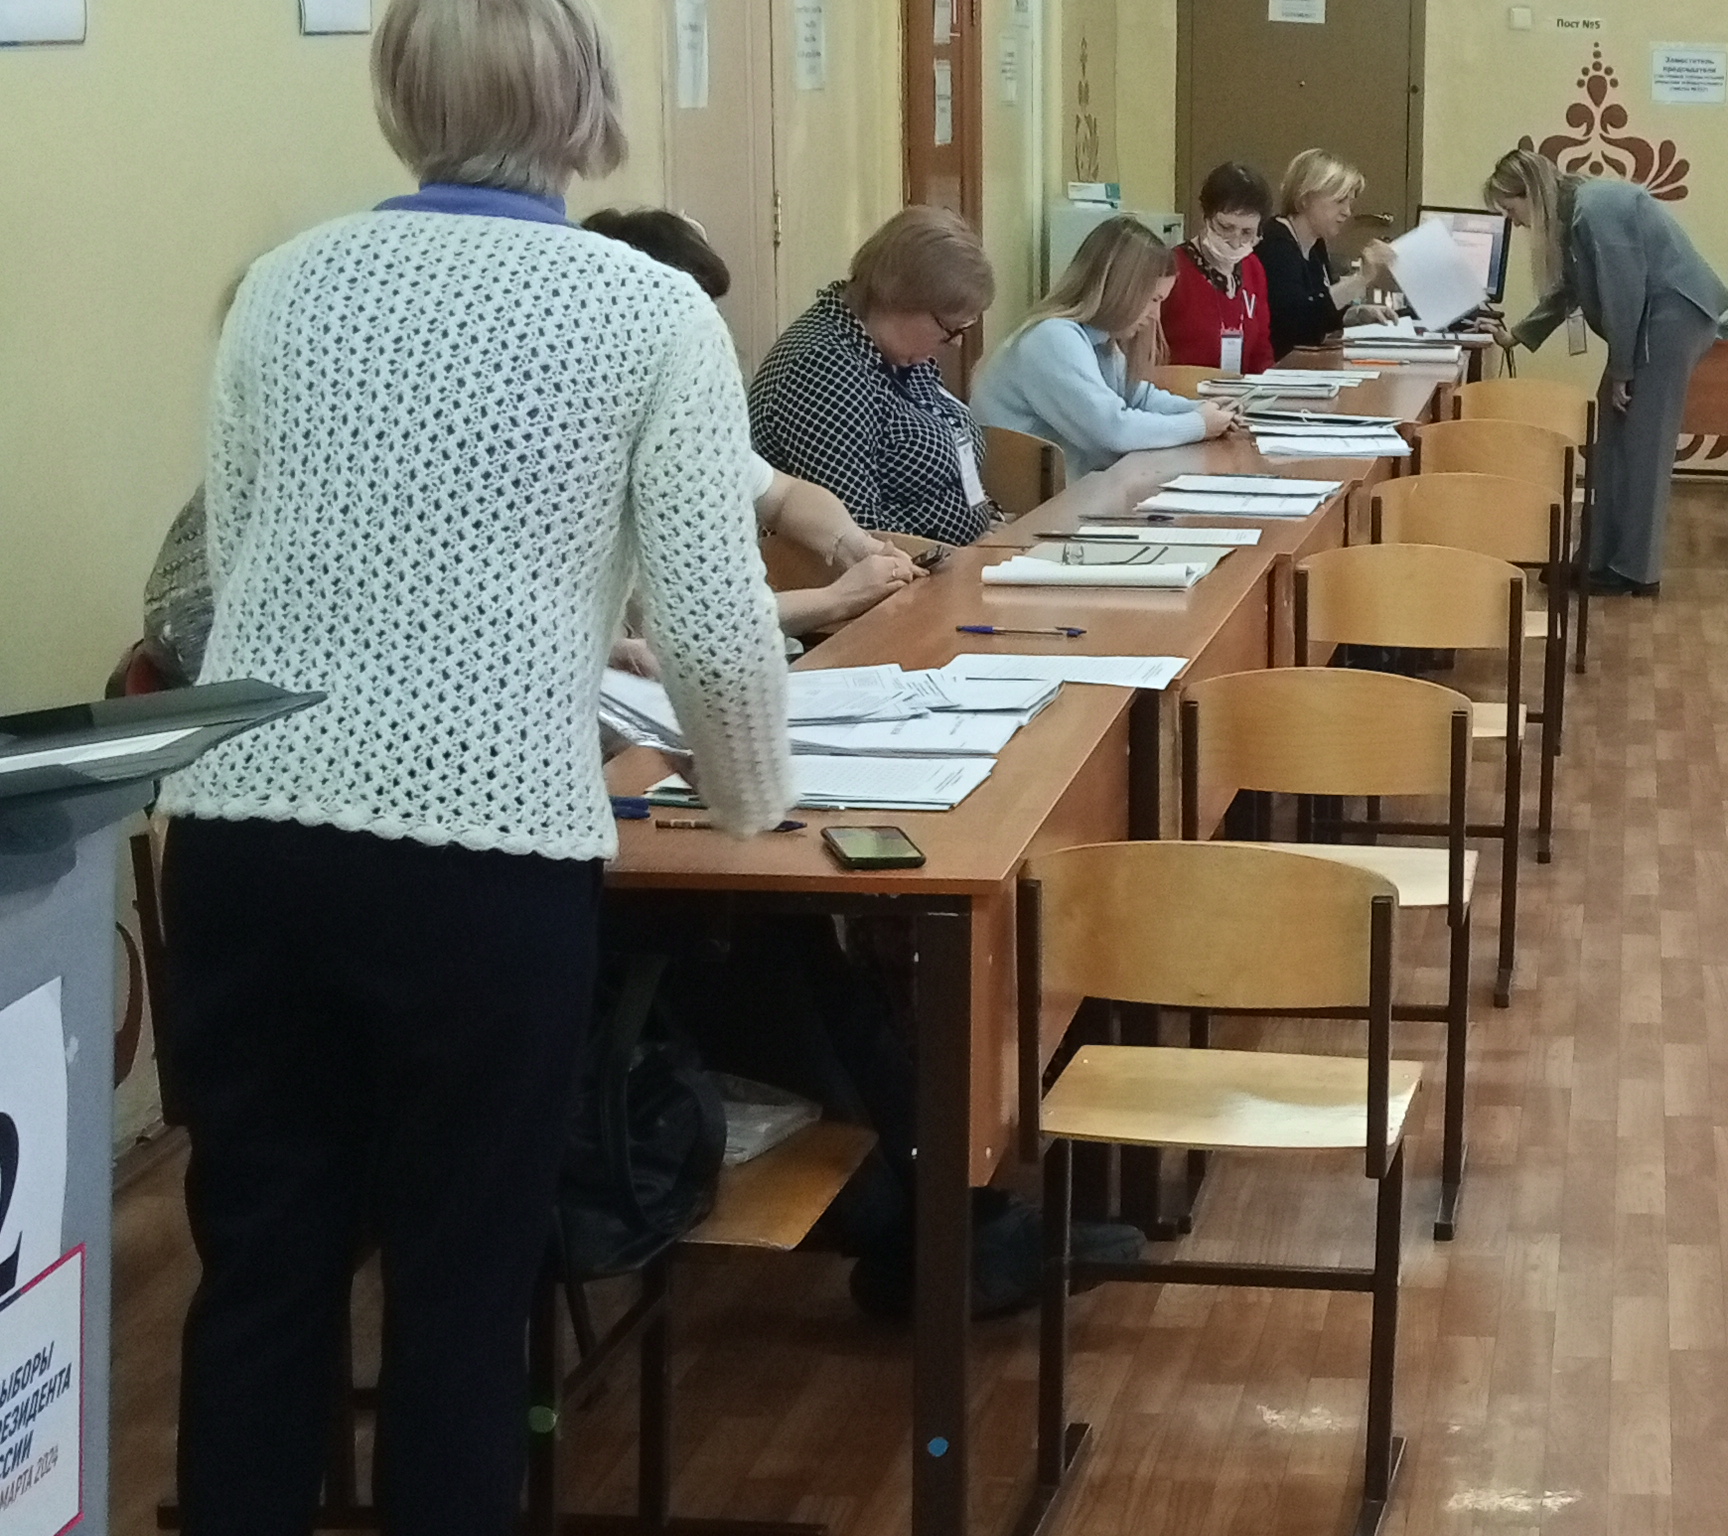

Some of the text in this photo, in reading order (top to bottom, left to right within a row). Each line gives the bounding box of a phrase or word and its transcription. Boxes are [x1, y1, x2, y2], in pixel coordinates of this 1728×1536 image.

[1556, 18, 1600, 29] Пост №5
[0, 1340, 55, 1409] ЫБОРЫ
